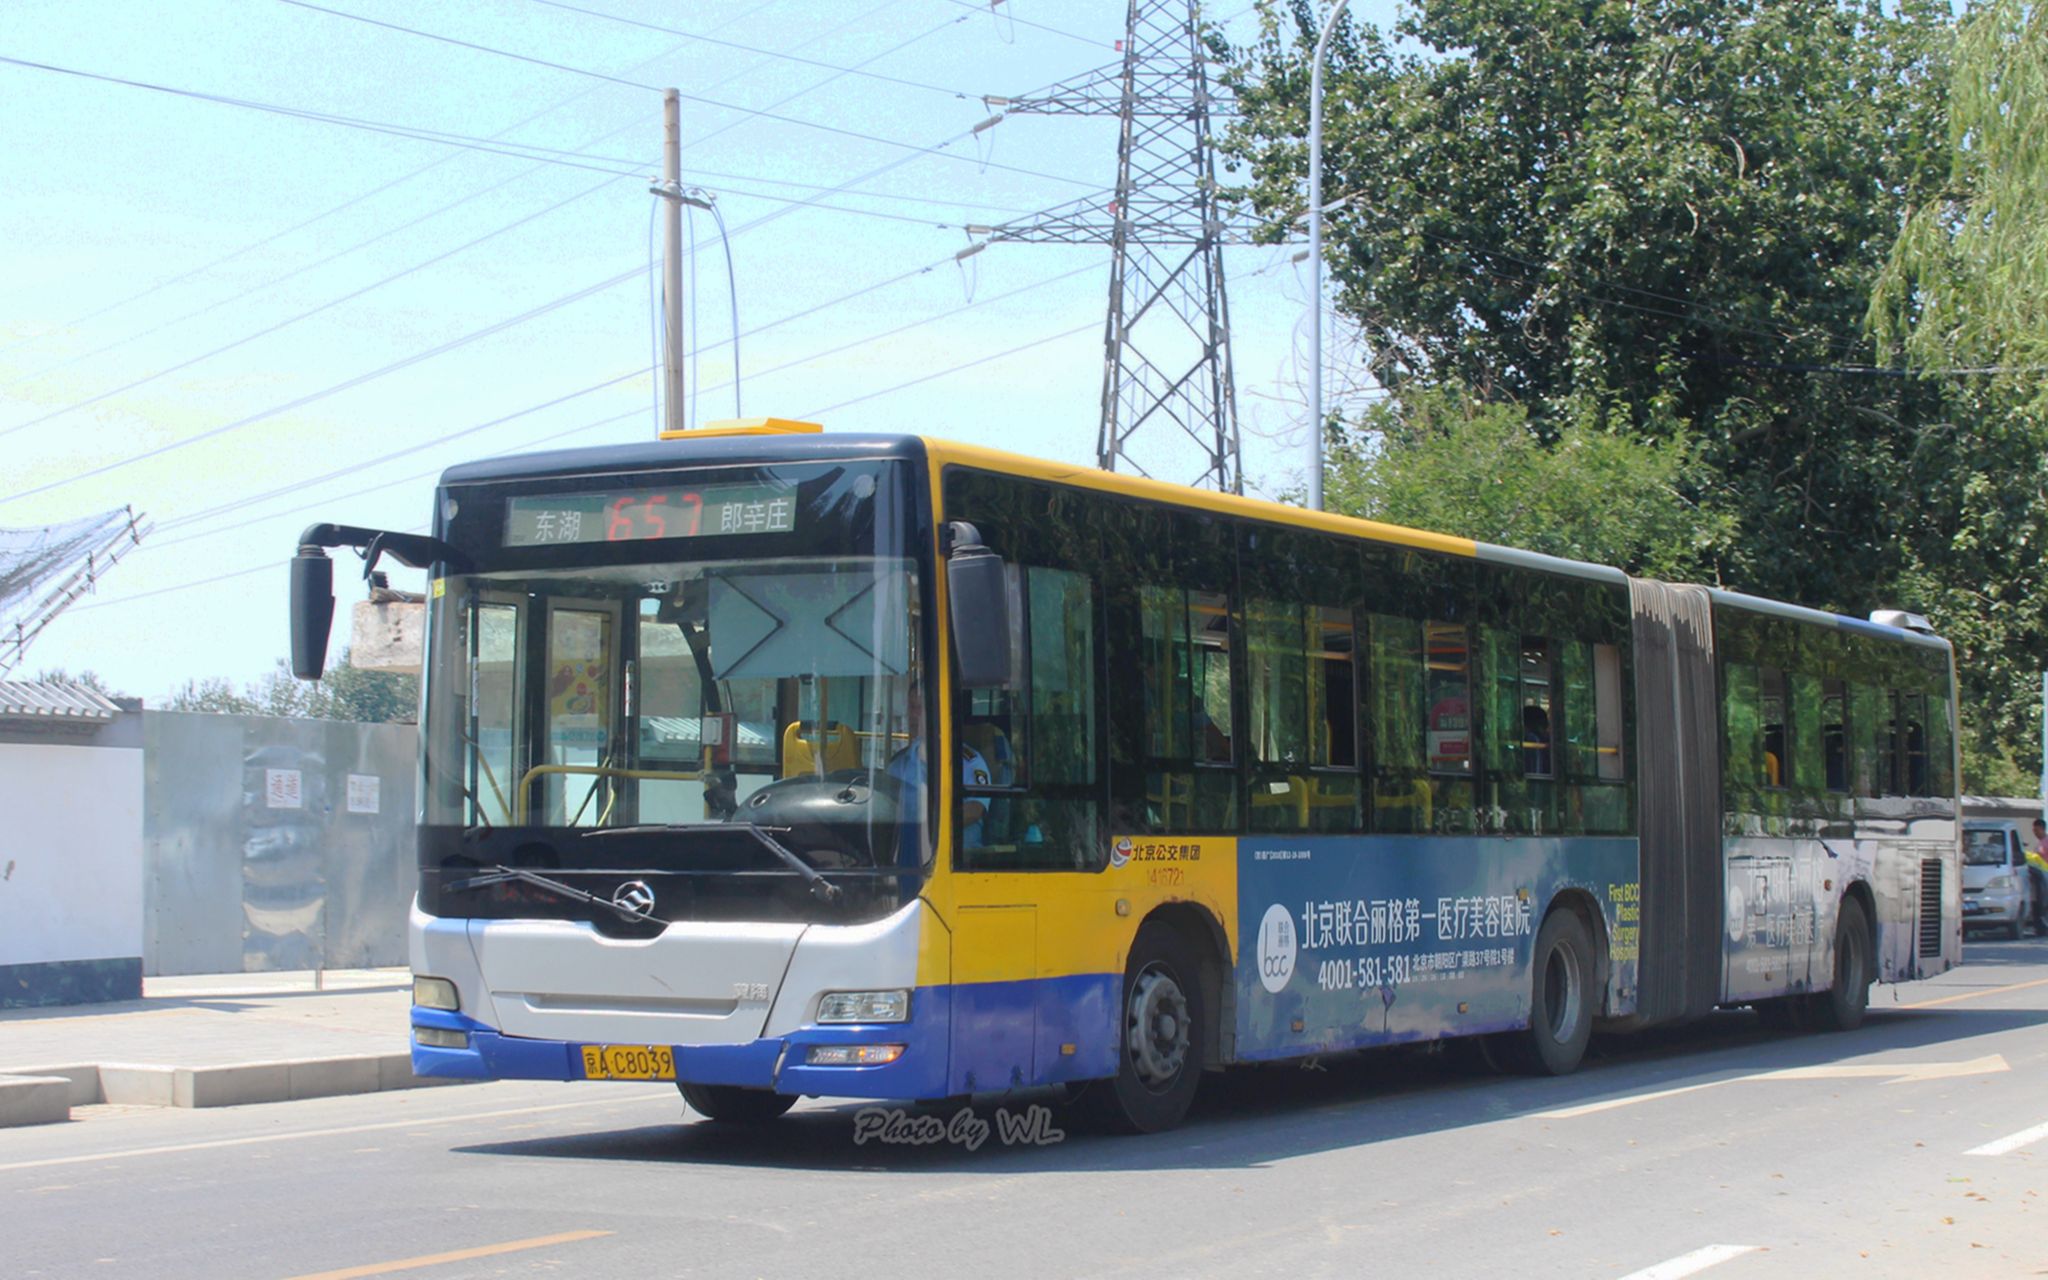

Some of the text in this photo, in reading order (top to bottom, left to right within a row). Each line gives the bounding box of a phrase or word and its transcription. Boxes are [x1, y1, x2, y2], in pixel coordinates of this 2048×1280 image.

[534, 511, 582, 542] 东湖
[607, 493, 703, 543] 657
[720, 498, 789, 533] 郎辛庄
[1132, 844, 1201, 862] 北京公交集团
[1301, 894, 1531, 949] 北京联合丽格第一医疗美容医院
[1263, 921, 1289, 978] bcc
[1318, 954, 1411, 991] 4001-581-581
